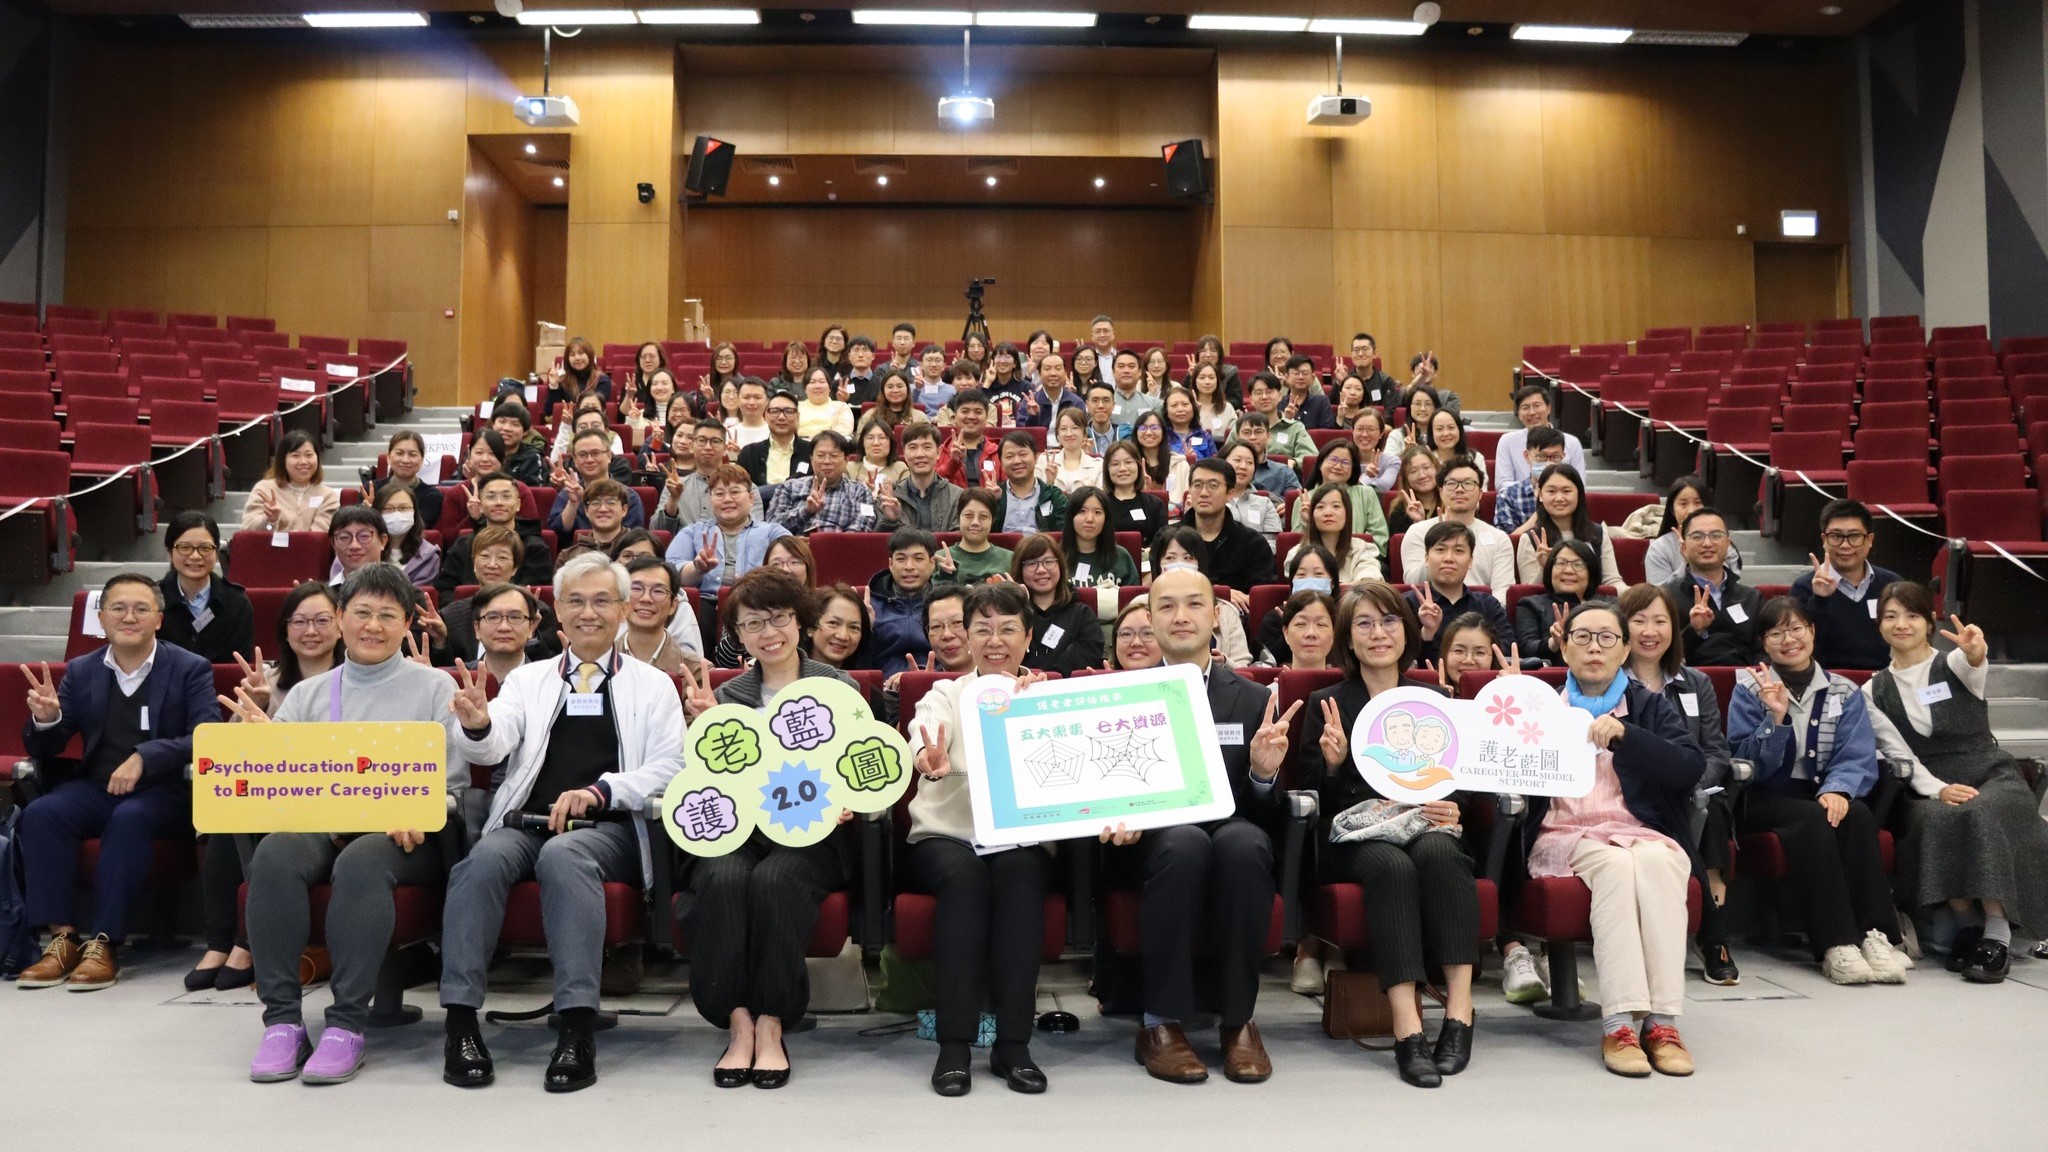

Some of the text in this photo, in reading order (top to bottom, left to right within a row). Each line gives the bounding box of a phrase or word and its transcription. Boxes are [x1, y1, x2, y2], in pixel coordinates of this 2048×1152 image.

[1096, 713, 1167, 733] 七大資源
[199, 757, 438, 776] Psychoeducation Program
[1480, 740, 1559, 777] 護老藍圖
[686, 705, 890, 837] 護 老 藍 圖
[1460, 766, 1576, 782] CAREGIVER MODEL
[214, 779, 430, 800] to Empower Caregivers
[1498, 778, 1547, 788] SUPPORT
[772, 780, 817, 811] 2.0
